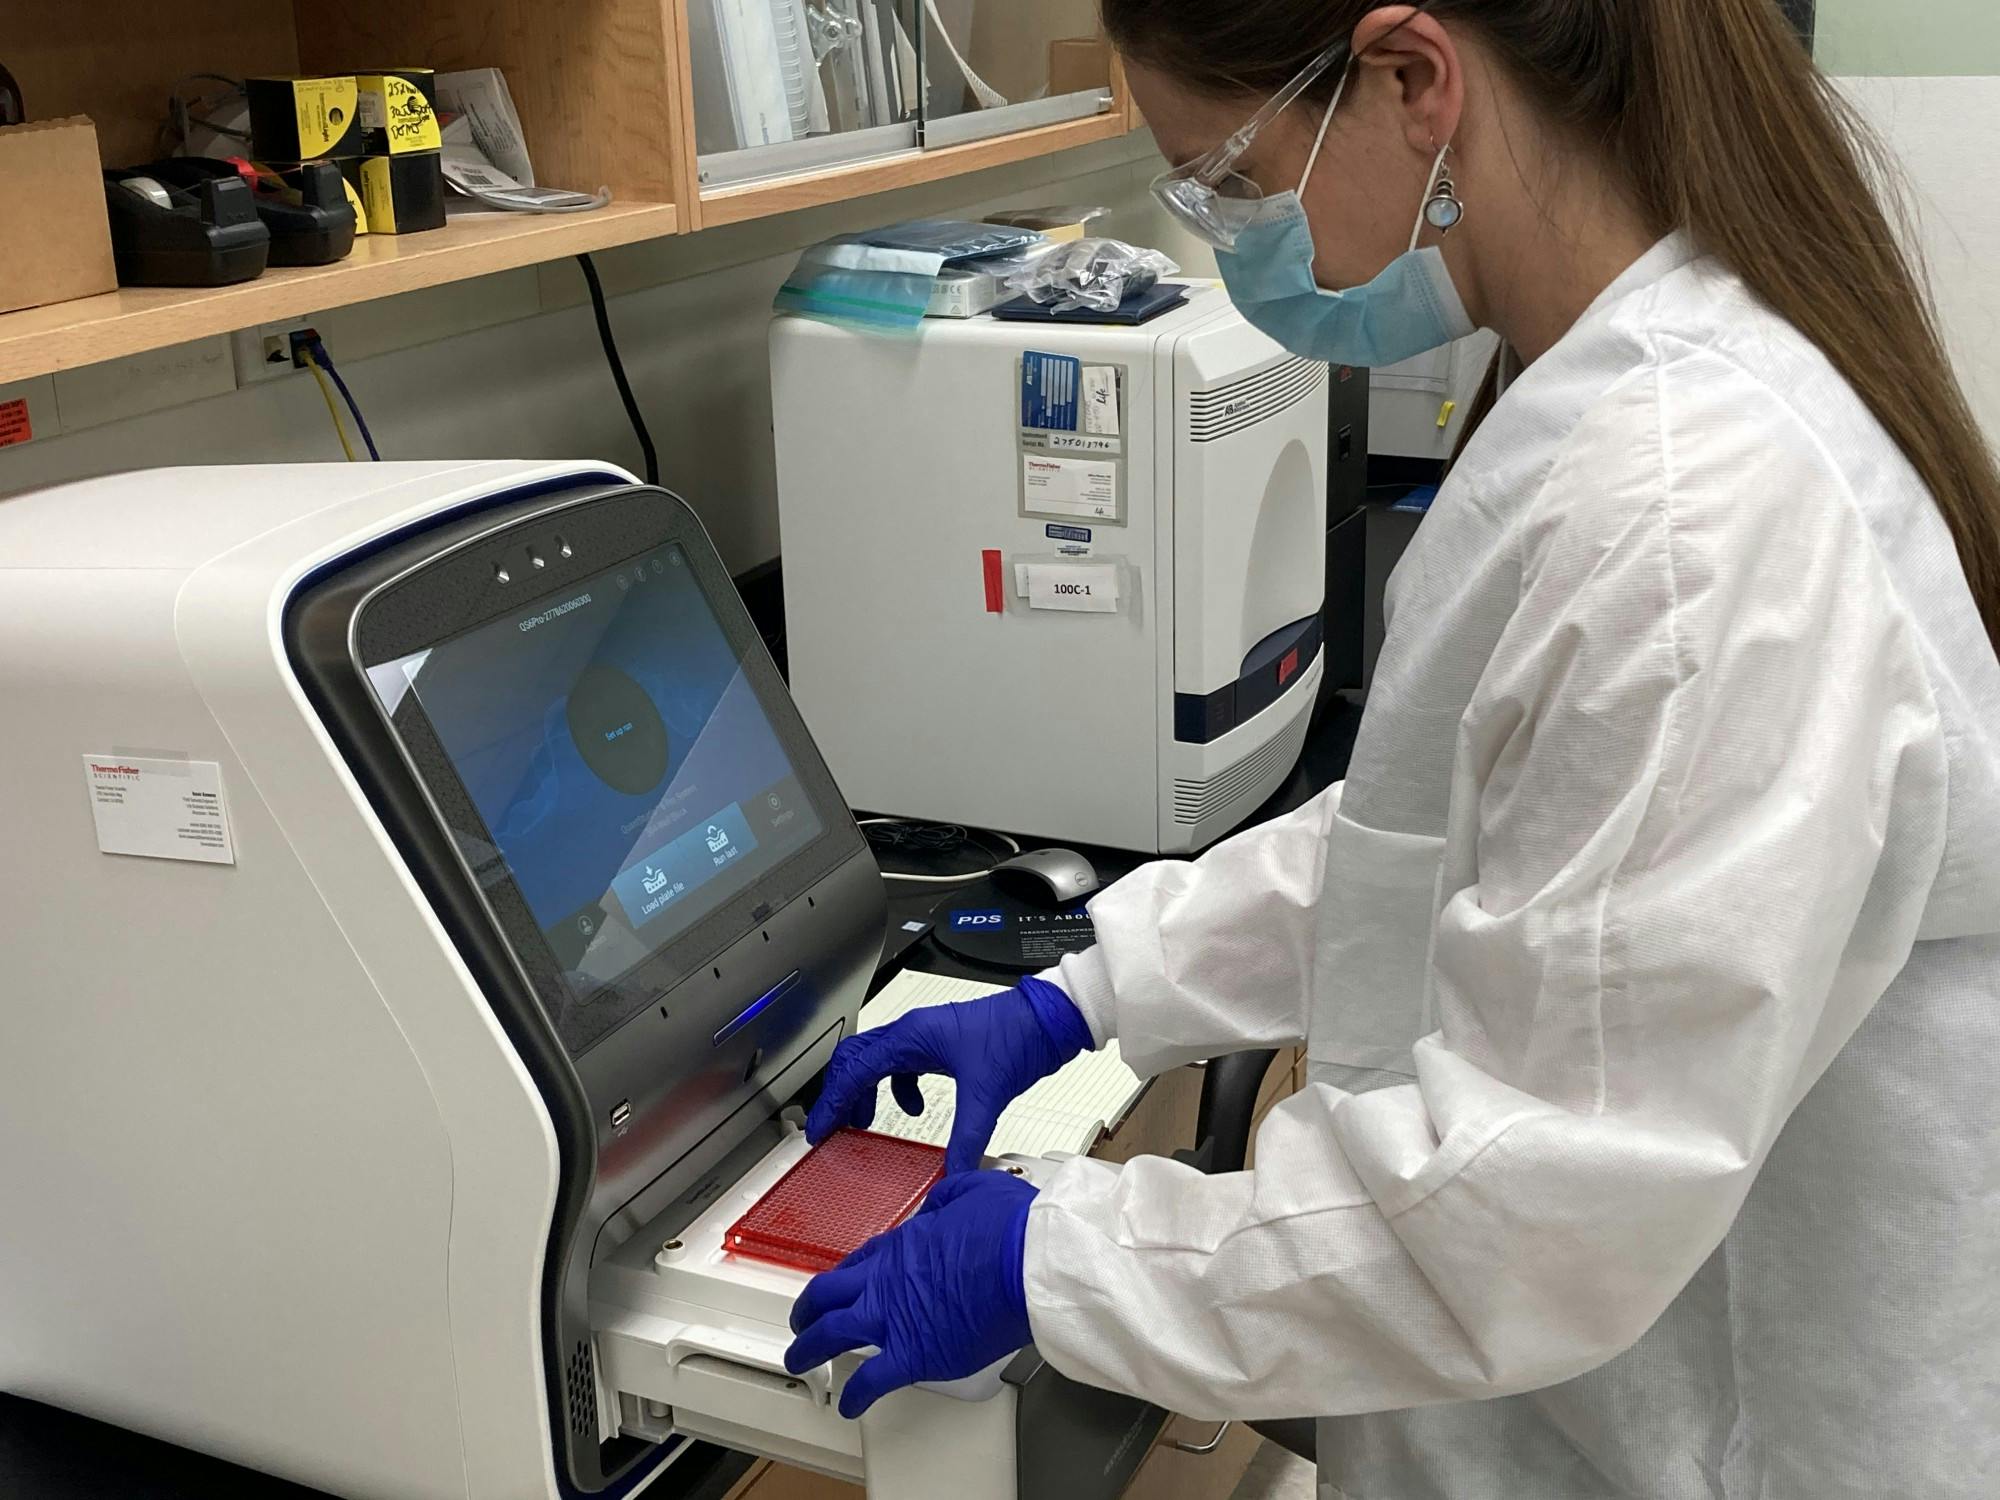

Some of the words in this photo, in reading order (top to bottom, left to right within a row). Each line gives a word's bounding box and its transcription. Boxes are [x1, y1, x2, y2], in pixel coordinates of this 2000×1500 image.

[1054, 584, 1091, 595] 100C-1
[93, 772, 141, 781] SCIENTIFIC
[713, 853, 727, 867] Run
[725, 845, 739, 861] last
[641, 898, 659, 915] Load
[659, 888, 675, 907] plate
[673, 881, 685, 896] file
[957, 914, 1002, 925] PDS
[1018, 915, 1047, 923] IT'S
